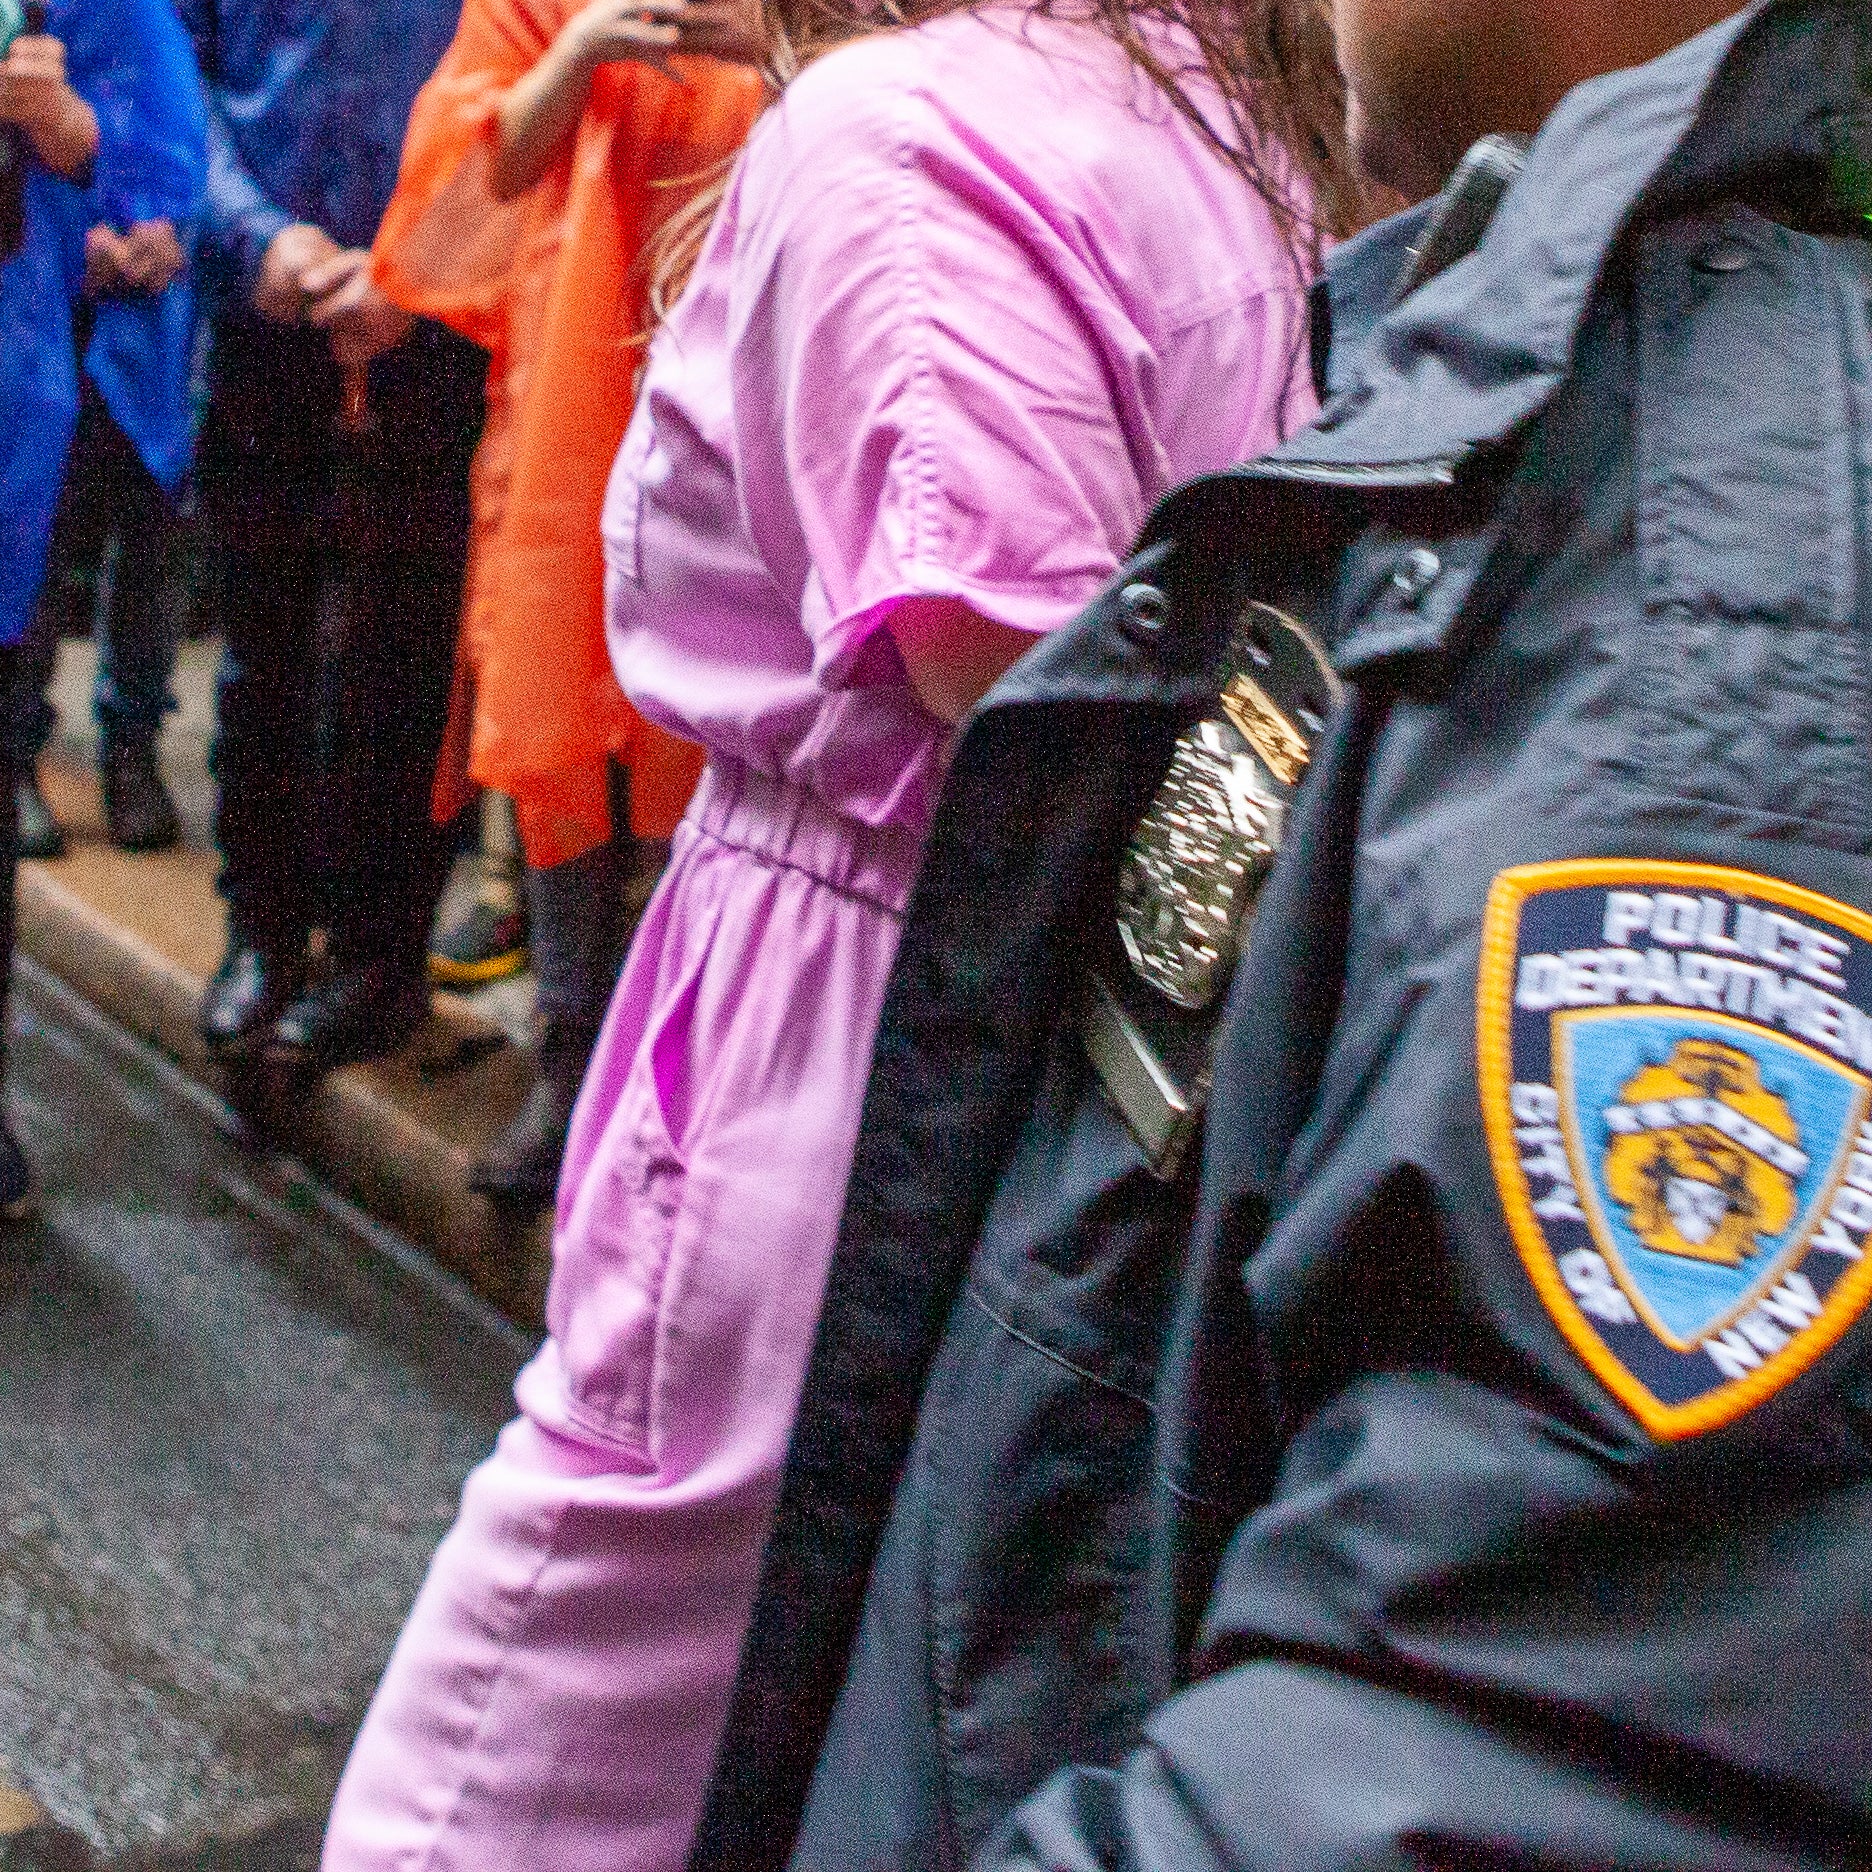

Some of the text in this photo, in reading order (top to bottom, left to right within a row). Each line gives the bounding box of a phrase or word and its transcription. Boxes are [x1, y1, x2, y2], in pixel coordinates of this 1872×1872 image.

[1601, 890, 1850, 991] POLICE
[1510, 1080, 1639, 1326] CITY OF
[1702, 1271, 1825, 1380] NEW
